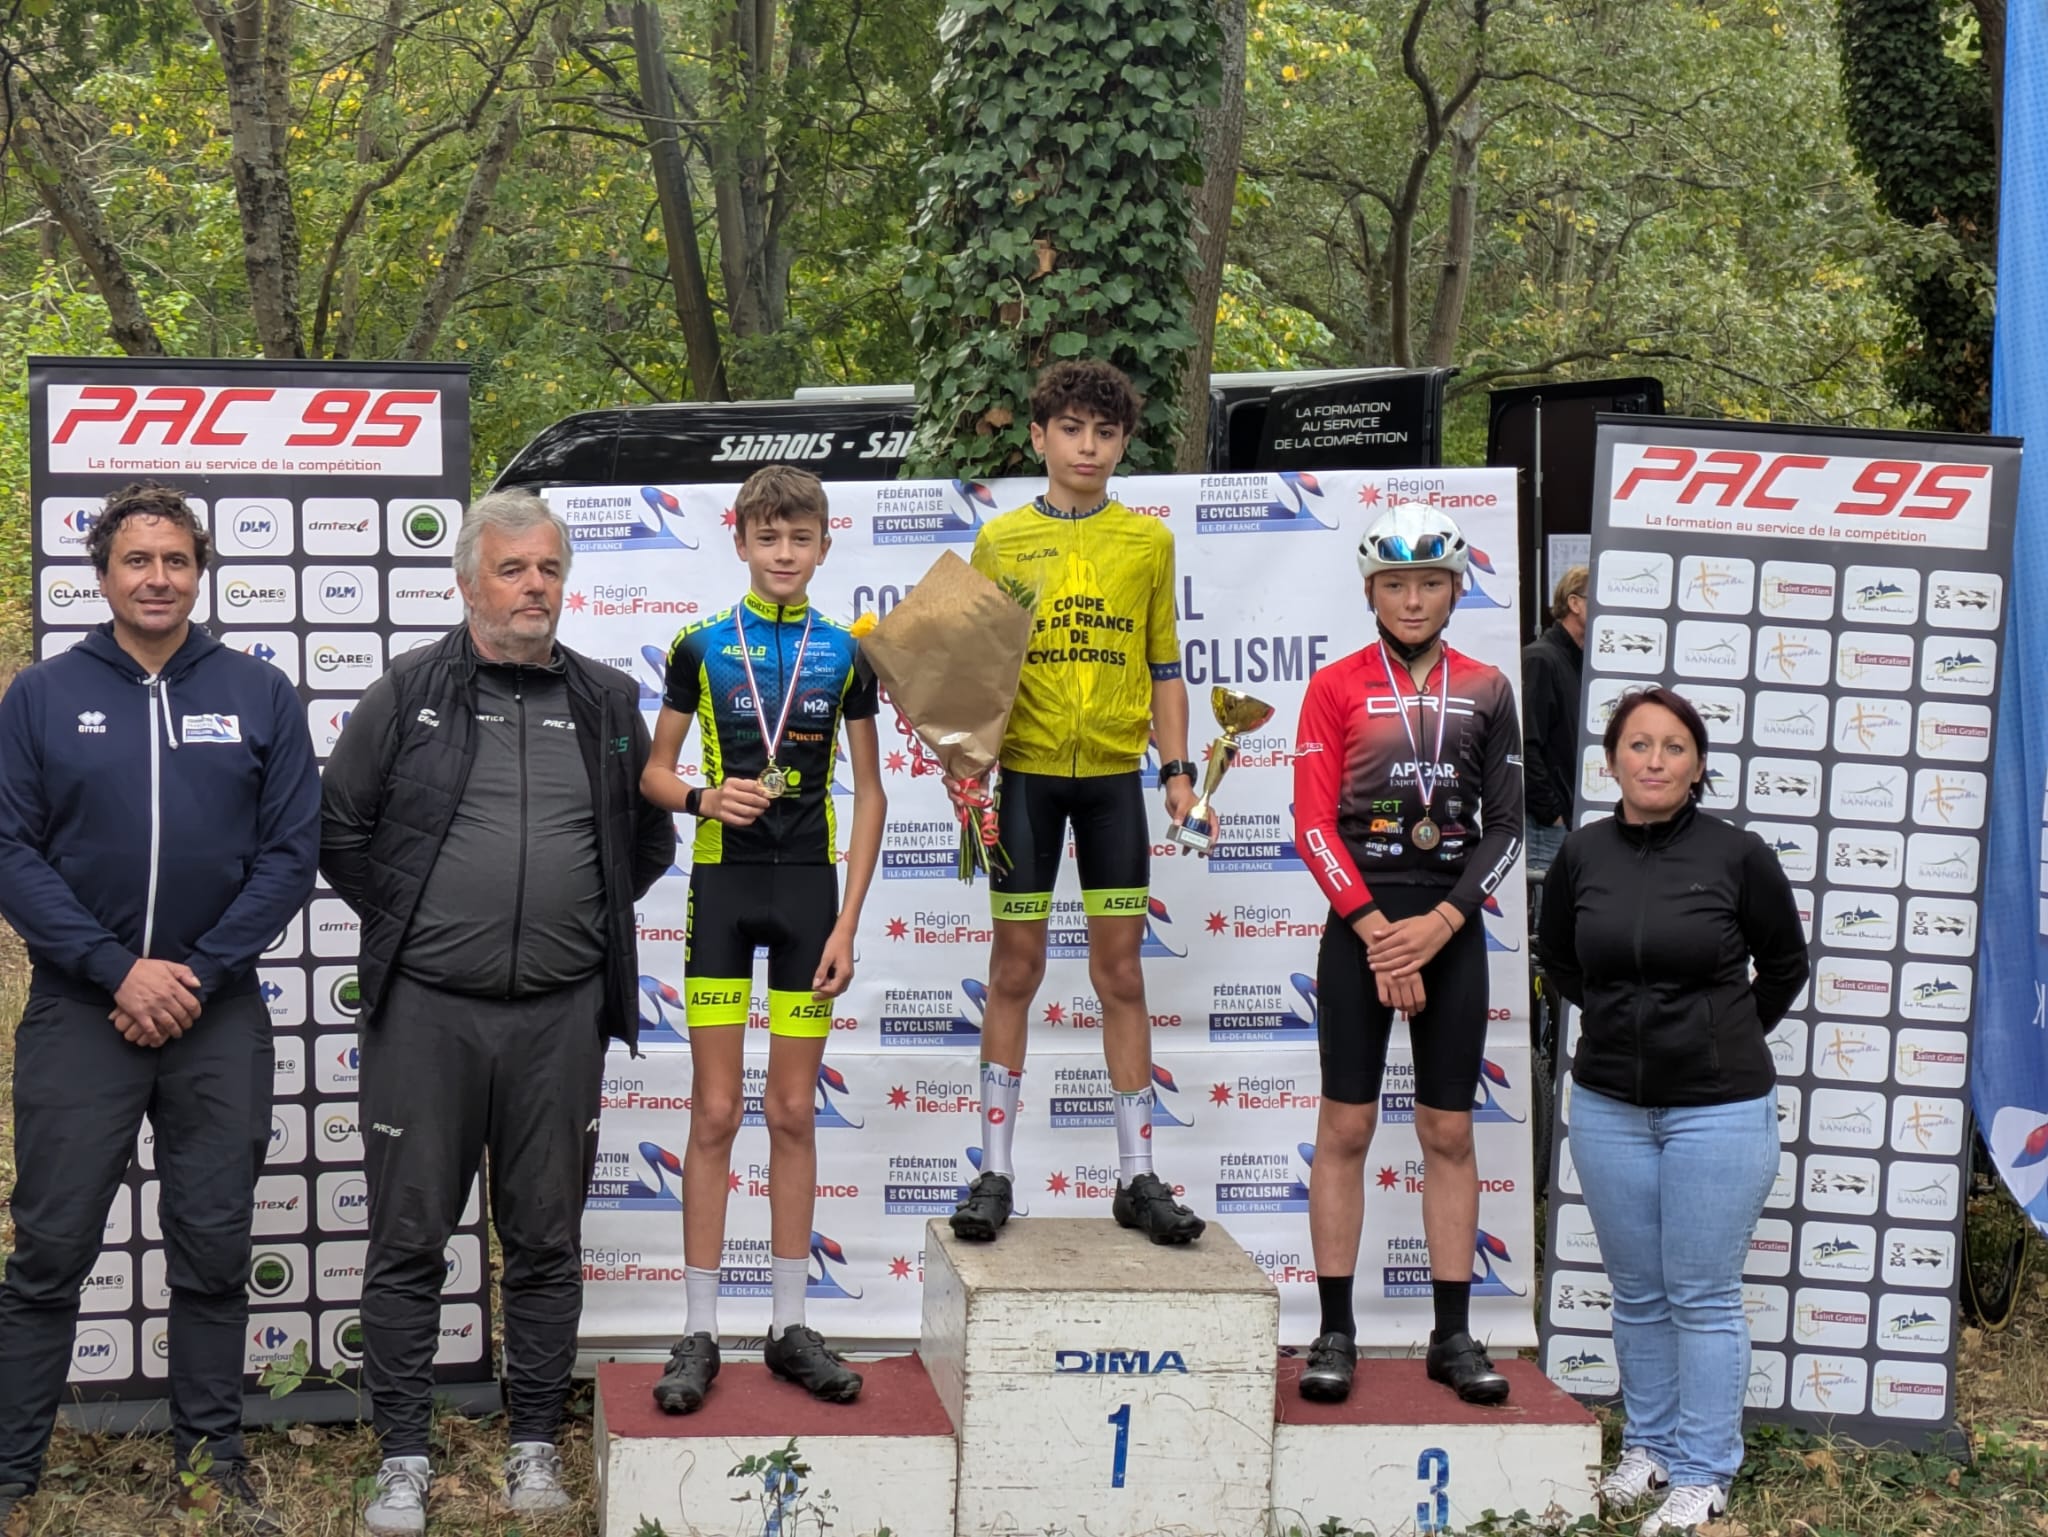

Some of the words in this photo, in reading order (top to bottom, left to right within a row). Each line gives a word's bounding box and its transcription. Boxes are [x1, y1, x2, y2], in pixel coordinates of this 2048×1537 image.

[51, 386, 276, 446] PAC
[284, 389, 439, 447] 95
[1296, 408, 1312, 419] LA
[1314, 402, 1391, 418] FORMATION
[1301, 421, 1320, 432] AU
[1323, 416, 1381, 432] SERVICE
[1274, 439, 1293, 450] DE
[1294, 438, 1312, 449] LA
[1314, 431, 1408, 449] COMPÉTITION
[88, 457, 105, 469] La
[110, 457, 180, 470] formation
[185, 460, 202, 470] au
[207, 459, 257, 471] service
[261, 459, 278, 470] de
[282, 459, 294, 470] la
[299, 458, 382, 473] compétition
[1201, 476, 1268, 489] FÉDÉRATION
[1387, 477, 1444, 494] Région
[1613, 446, 1832, 511] PAC
[1833, 460, 1990, 520] 95
[877, 486, 943, 499] FÉDÉRATION
[567, 496, 632, 508] FÉDÉRATION
[877, 500, 943, 513] FRANÇAISE
[566, 509, 632, 522] FRANÇAISE
[1210, 506, 1269, 519] CYCLISME
[239, 521, 271, 533] DLM
[886, 517, 944, 531] CYCLISME
[1646, 513, 1661, 526] La
[1666, 514, 1732, 531] formation
[1737, 521, 1752, 532] au
[1757, 522, 1805, 536] service
[1809, 524, 1825, 536] de
[1829, 526, 1841, 538] la
[1845, 527, 1927, 543] compétition
[575, 526, 632, 539] CYCLISME
[54, 588, 101, 599] CLARE
[325, 586, 356, 599] DLM
[593, 584, 648, 601] Région
[1780, 584, 1799, 594] Saint
[1054, 594, 1105, 612] COUPE
[1051, 613, 1070, 629] DE
[1076, 612, 1135, 633] FRANCE
[1070, 629, 1089, 644] DE
[1027, 650, 1127, 666] CYCLOCROSS
[1183, 634, 1329, 685] CLISME
[1857, 655, 1877, 665] Saint
[1937, 725, 1957, 735] Saint
[1217, 813, 1280, 826] ÉDÉRATION
[887, 821, 953, 833] FÉDÉRATION
[1220, 828, 1280, 840] RANÇAISE
[887, 834, 954, 848] FRANÇAISE
[896, 852, 954, 864] CYCLISME
[1222, 845, 1281, 858] CYCLISME
[1003, 900, 1048, 914] ASELB
[1234, 905, 1291, 922] Région
[914, 911, 970, 928] Région
[1213, 983, 1281, 996] FÉDÉRATION
[1835, 980, 1856, 990] Saint
[691, 991, 742, 1005] ASELB
[885, 988, 953, 1001] FÉDÉRATION
[885, 1002, 953, 1016] FRANÇAISE
[1213, 998, 1282, 1011] FRANÇAISE
[894, 1020, 953, 1032] CYCLISME
[1223, 1016, 1283, 1027] CYCLISME
[1916, 1052, 1936, 1061] Saint
[916, 1080, 972, 1097] Région
[1238, 1075, 1295, 1093] Région
[1064, 1101, 1115, 1113] CYCLISM
[889, 1155, 957, 1168] FÉDÉRATION
[1220, 1153, 1288, 1166] FÉDÉRATION
[889, 1170, 957, 1184] FRANÇAISE
[1220, 1168, 1288, 1182] FRANÇAISE
[898, 1188, 958, 1200] CYCLISME
[1230, 1186, 1289, 1198] CYCLISME
[583, 1248, 641, 1265] Région
[1813, 1311, 1834, 1321] Saint
[77, 1344, 110, 1357] DLM
[1892, 1383, 1912, 1393] Saint
[1107, 1403, 1131, 1488] 1
[1416, 1447, 1451, 1532] 3
